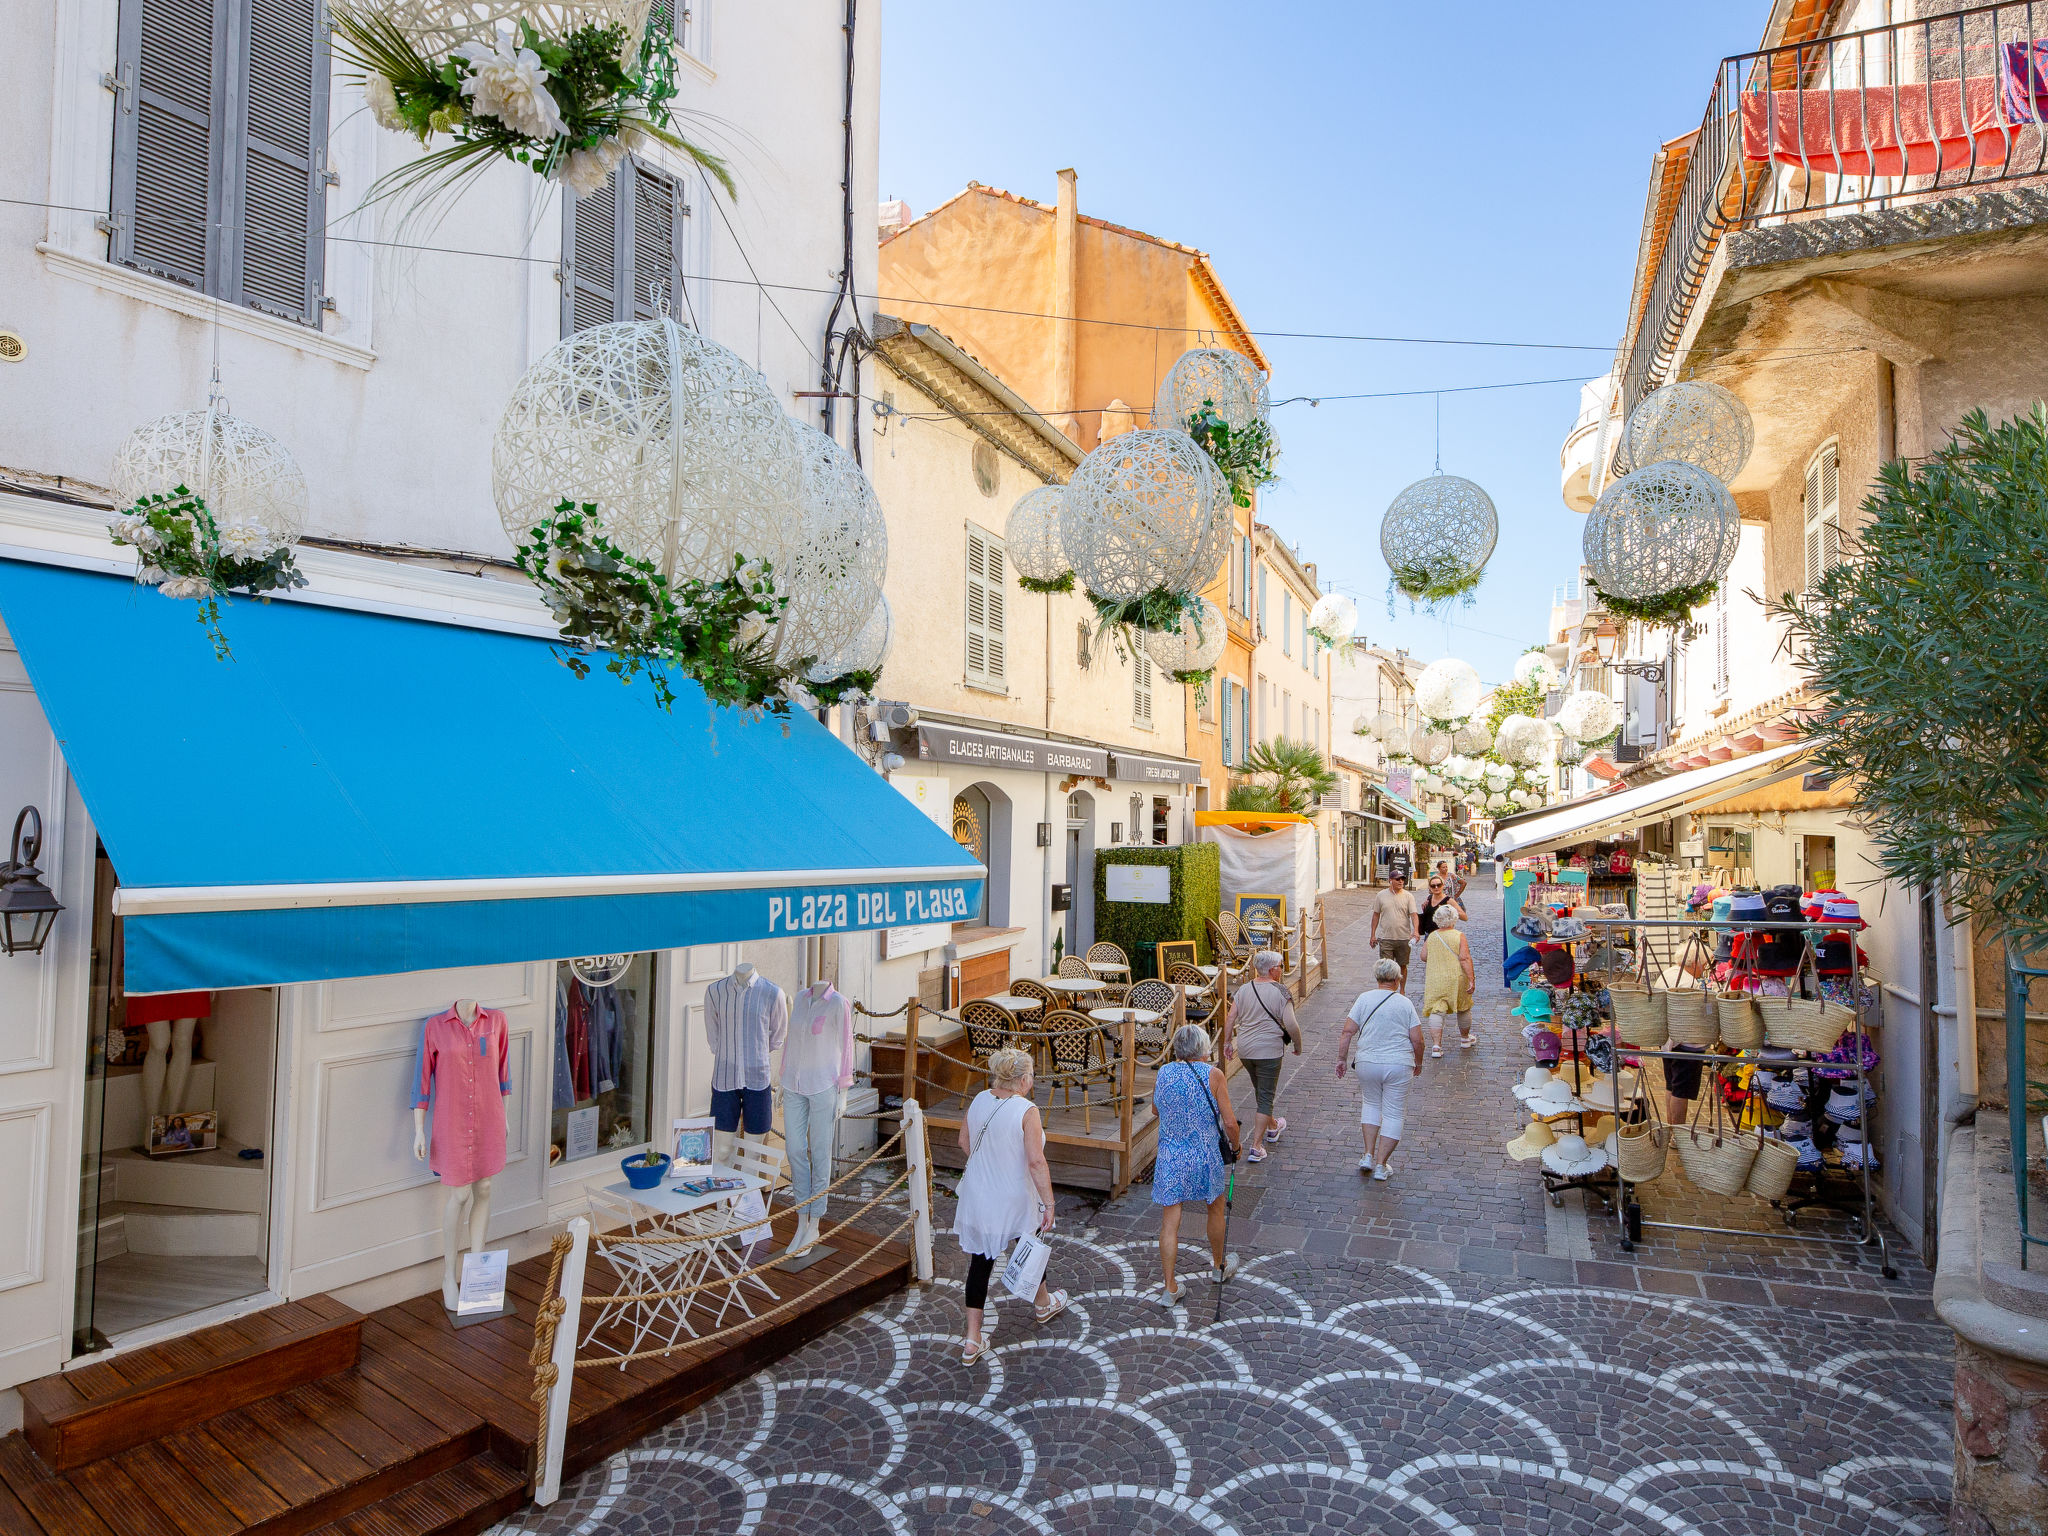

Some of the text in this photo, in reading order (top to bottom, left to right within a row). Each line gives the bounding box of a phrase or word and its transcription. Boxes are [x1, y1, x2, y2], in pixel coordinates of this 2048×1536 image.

[949, 739, 983, 758] GLACES
[984, 744, 1034, 764] ARTISANALES
[1047, 753, 1092, 770] BARBARAC
[1145, 766, 1180, 779] FRESH JUICE BAR
[576, 953, 625, 970] -50%
